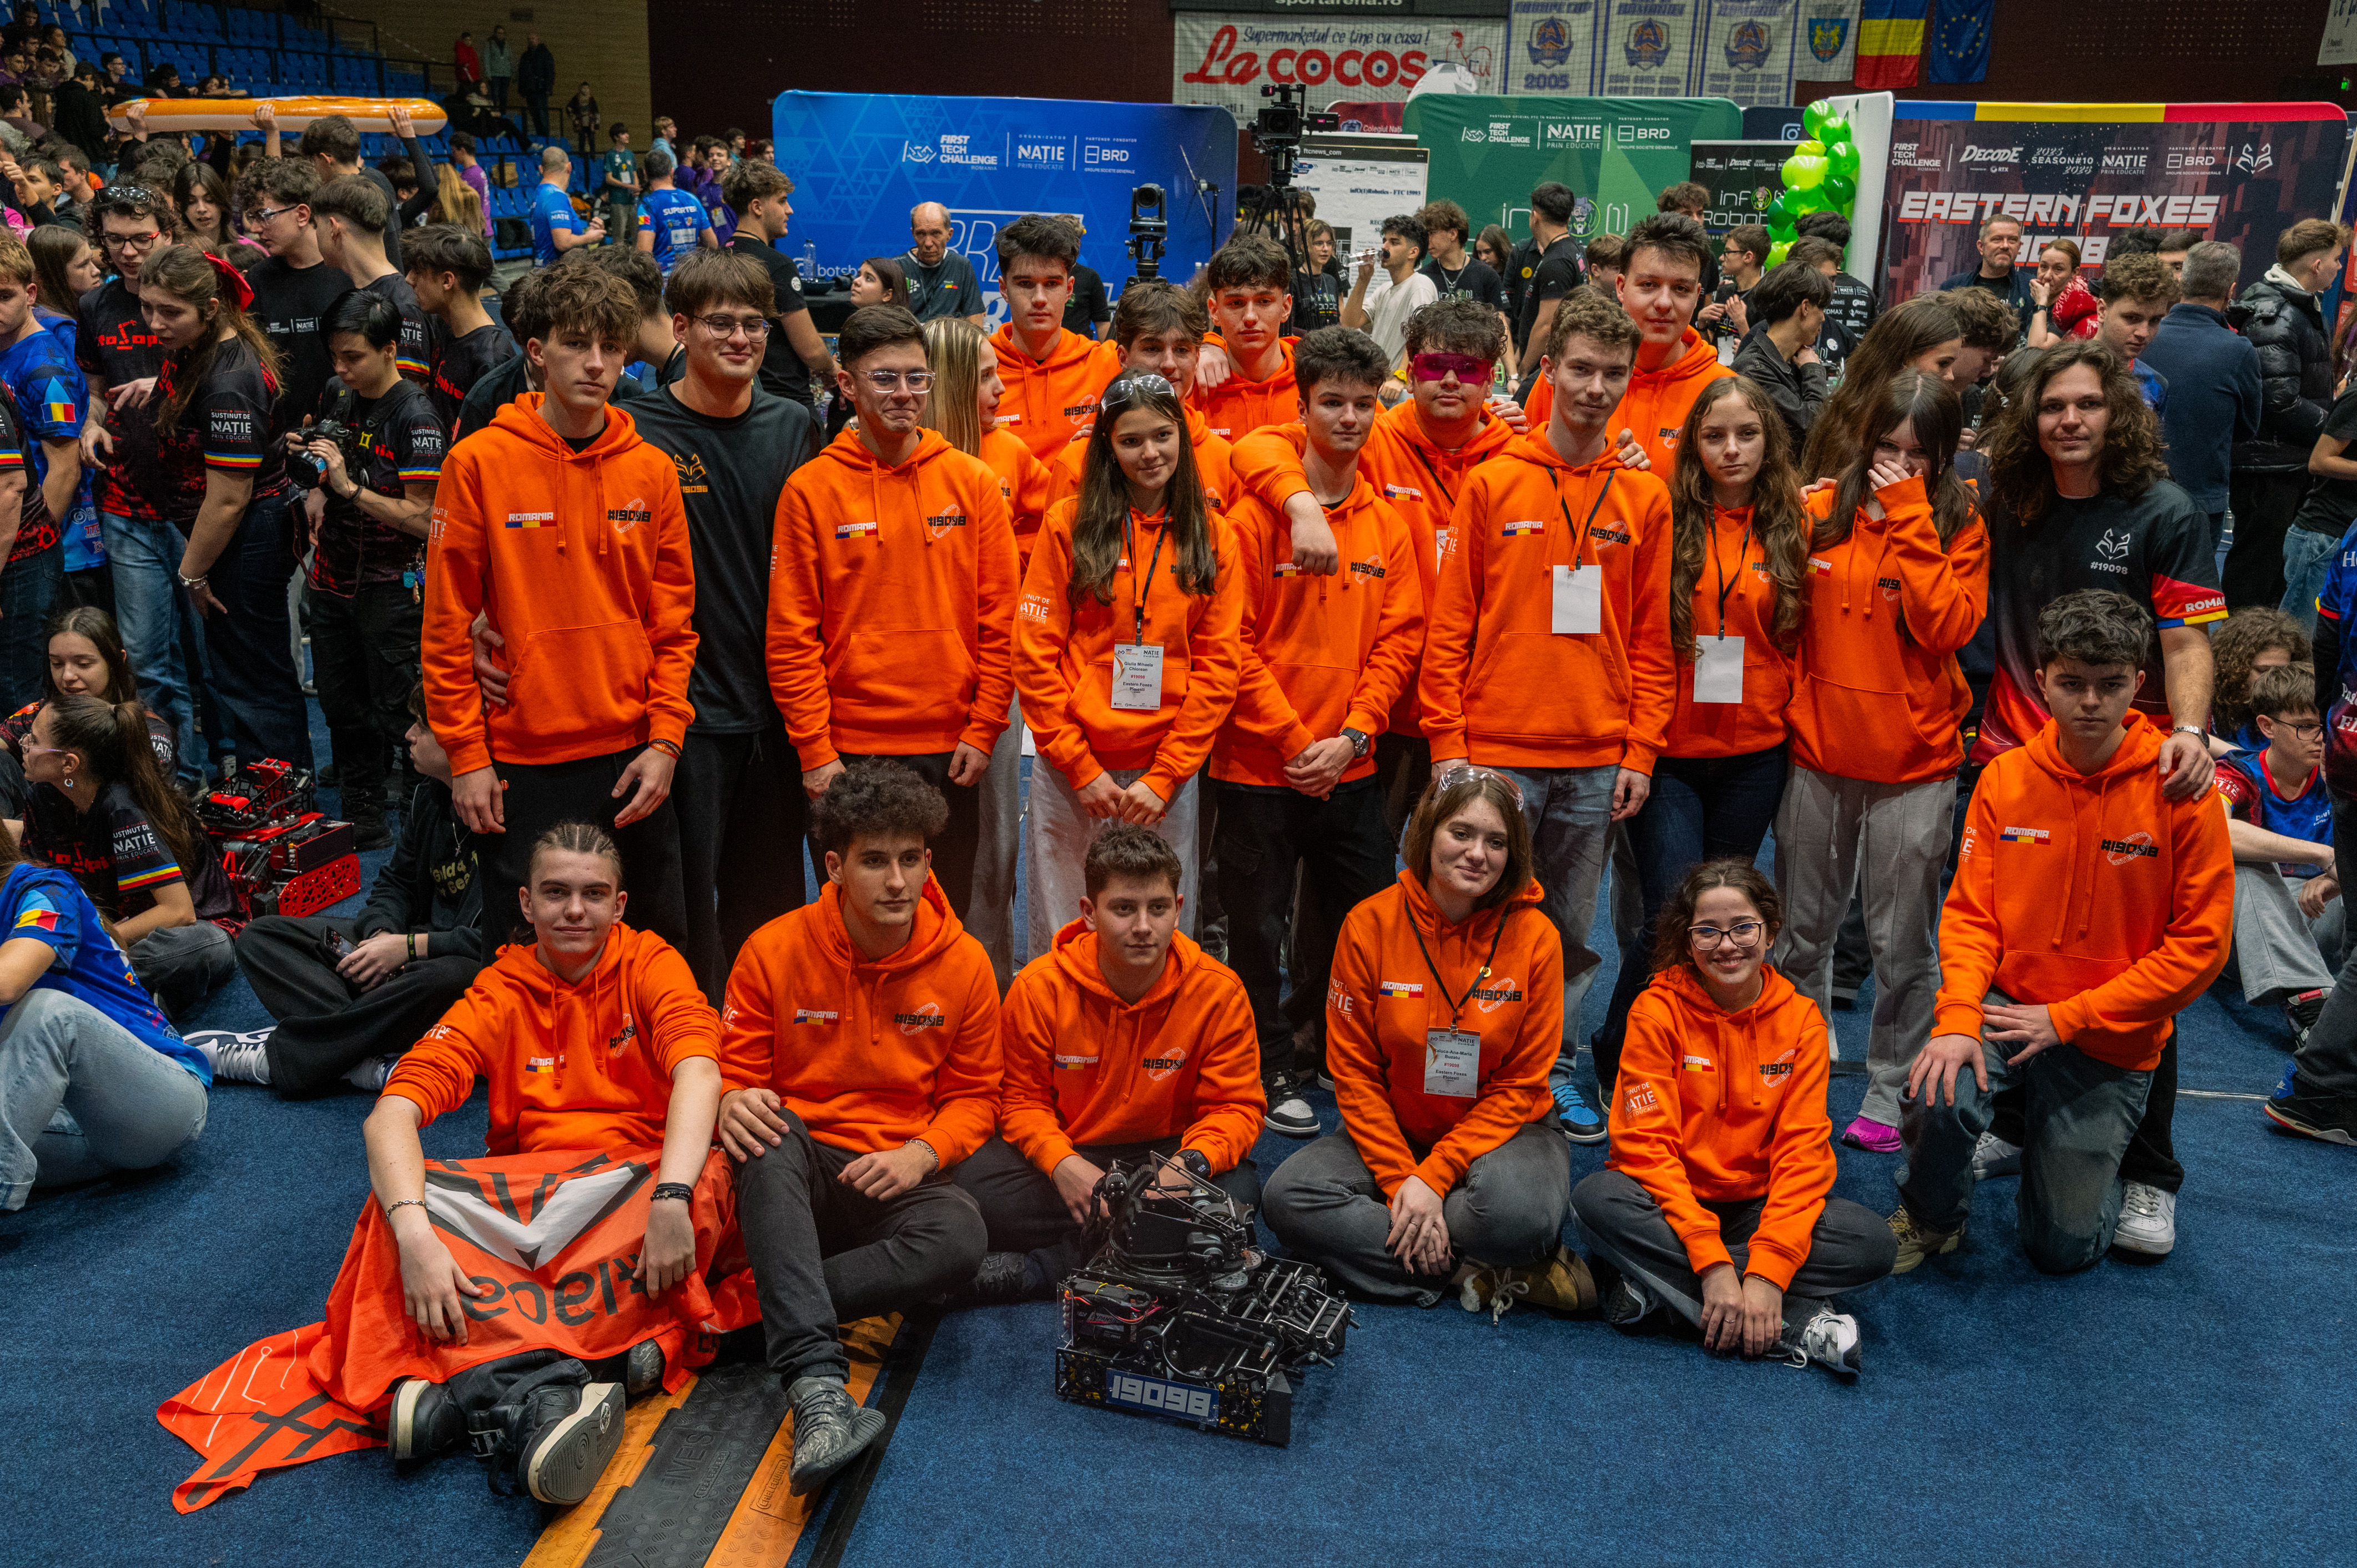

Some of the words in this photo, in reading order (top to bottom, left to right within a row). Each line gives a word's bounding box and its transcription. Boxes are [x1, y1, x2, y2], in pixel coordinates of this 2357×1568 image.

[1243, 26, 1330, 46] Supermarketul
[1333, 30, 1346, 44] ce
[1376, 30, 1389, 44] cu
[1182, 25, 1262, 85] La
[1524, 73, 1570, 90] 2005
[1363, 125, 1388, 133] Colegiul
[1547, 124, 1601, 142] NAȚIE
[1637, 128, 1670, 139] BRD
[940, 135, 970, 145] FIRST
[1488, 135, 1531, 144] CHALLENGE
[940, 145, 967, 154] TECH
[1018, 145, 1065, 164] NAȚIE
[1959, 145, 2024, 163] DECODE
[939, 155, 998, 165] CHALLENGE
[1101, 150, 1130, 162] BRD
[2031, 156, 2094, 165] SEASON#10
[2102, 155, 2148, 169] NAȚIE
[2184, 156, 2215, 166] BRD
[1892, 159, 1941, 167] CHALLENGE
[1898, 190, 2081, 226] EASTERN
[2084, 195, 2220, 228] FOXES
[210, 420, 251, 436] NAȚIE
[411, 436, 442, 451] NAȚIE
[1386, 483, 1422, 497] ROMANIA
[508, 512, 554, 522] ROMANIA
[837, 522, 877, 533] ROMANIA
[1505, 521, 1543, 530] ROMANIA
[2090, 561, 2128, 575] #19098
[1041, 596, 1050, 604] DE
[1965, 826, 1977, 836] DE
[2004, 826, 2050, 839] ROMANIA
[113, 833, 156, 854] NAȚIE
[2101, 839, 2159, 858] #19098
[1381, 980, 1423, 992] ROMANIA
[796, 1009, 839, 1020] ROMANIA
[1433, 1048, 1472, 1056] Raluca-Ana-Maria
[1055, 1053, 1099, 1064] ROMANIA
[1641, 1081, 1650, 1090] DE
[1112, 1375, 1212, 1418] 19098
